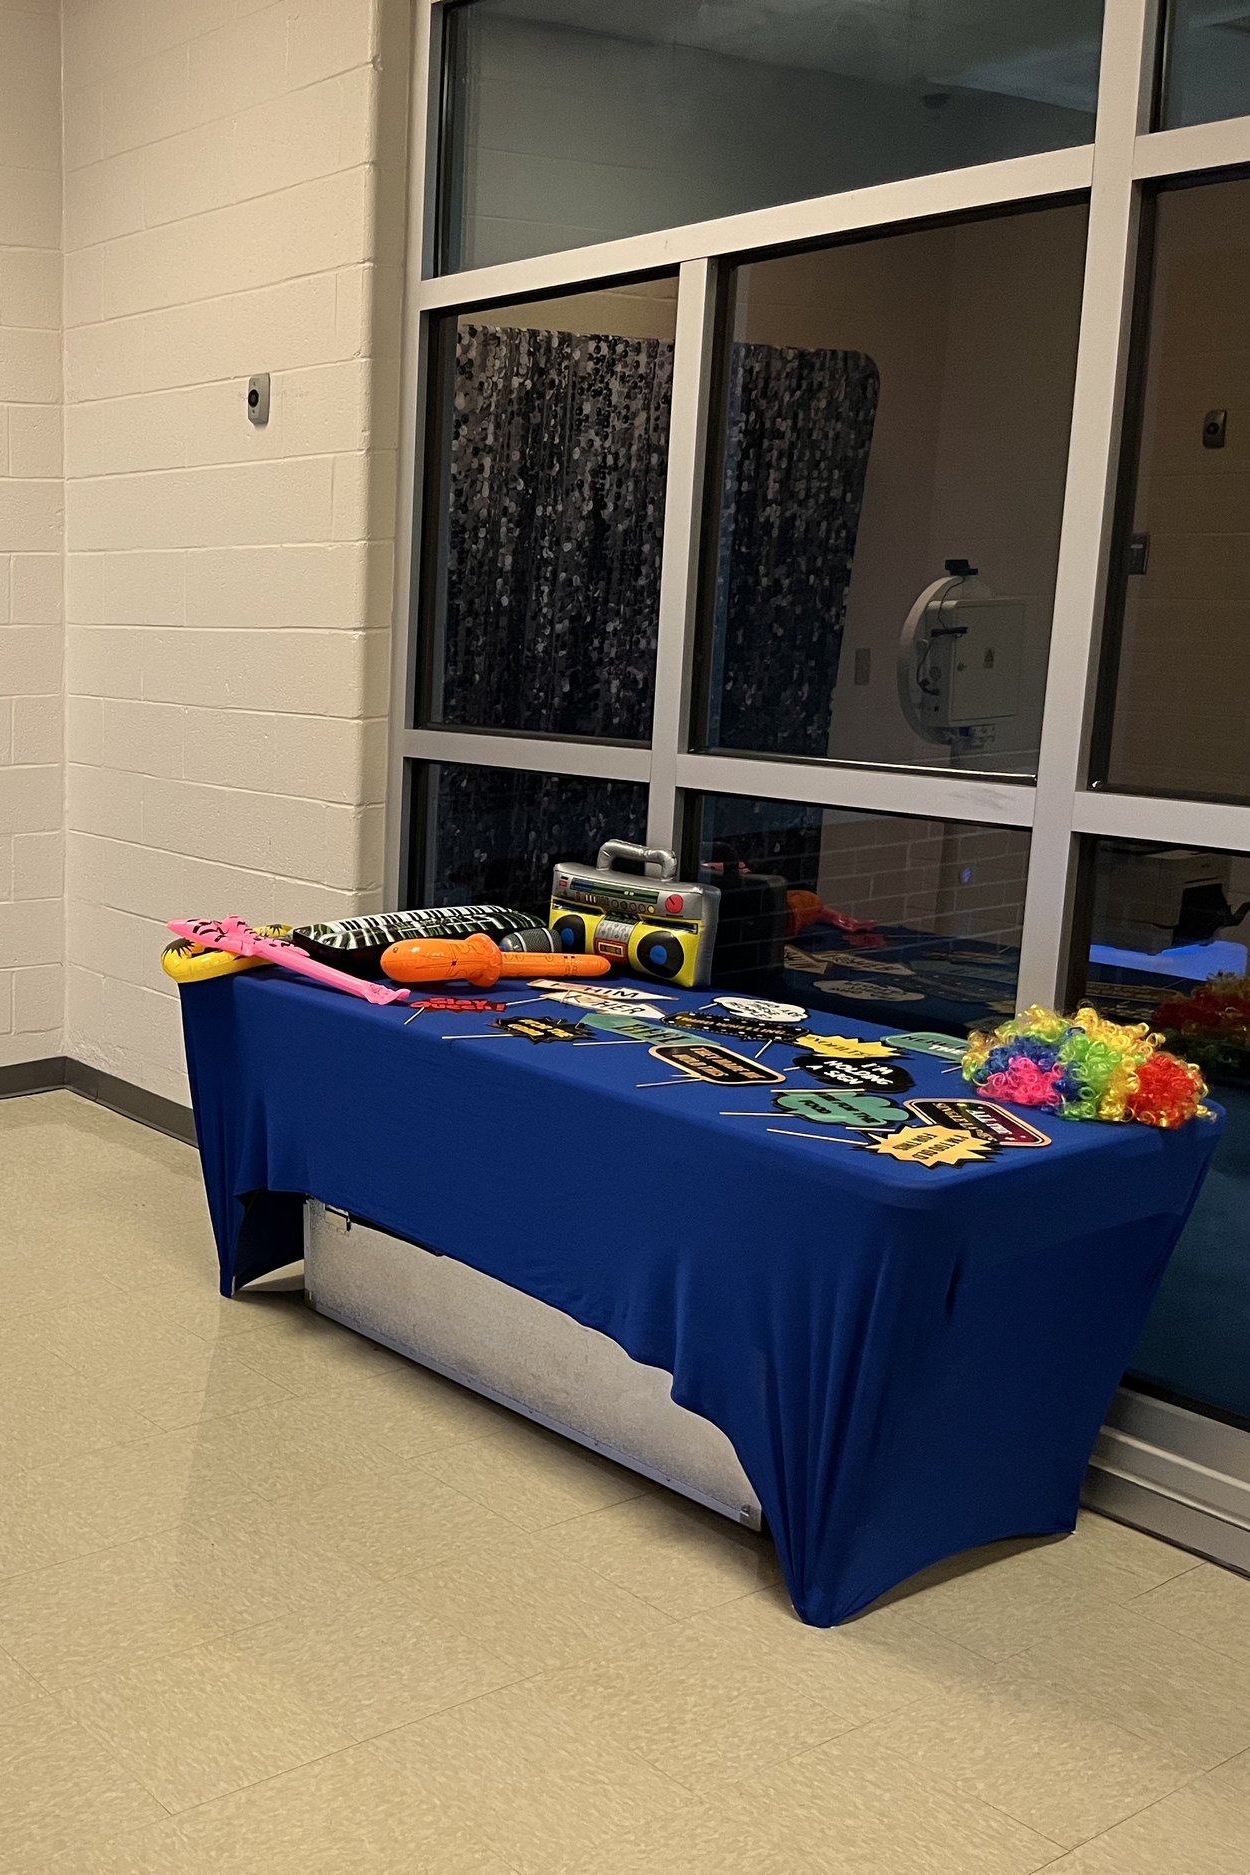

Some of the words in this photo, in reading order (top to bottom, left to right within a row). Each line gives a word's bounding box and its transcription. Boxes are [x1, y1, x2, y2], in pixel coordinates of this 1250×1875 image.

[584, 986, 639, 998] HIM
[593, 1000, 646, 1014] HER
[823, 1060, 894, 1085] HOLDING
[861, 1062, 894, 1075] I'M
[823, 1070, 864, 1085] SIGN
[797, 1099, 832, 1114] FOOD
